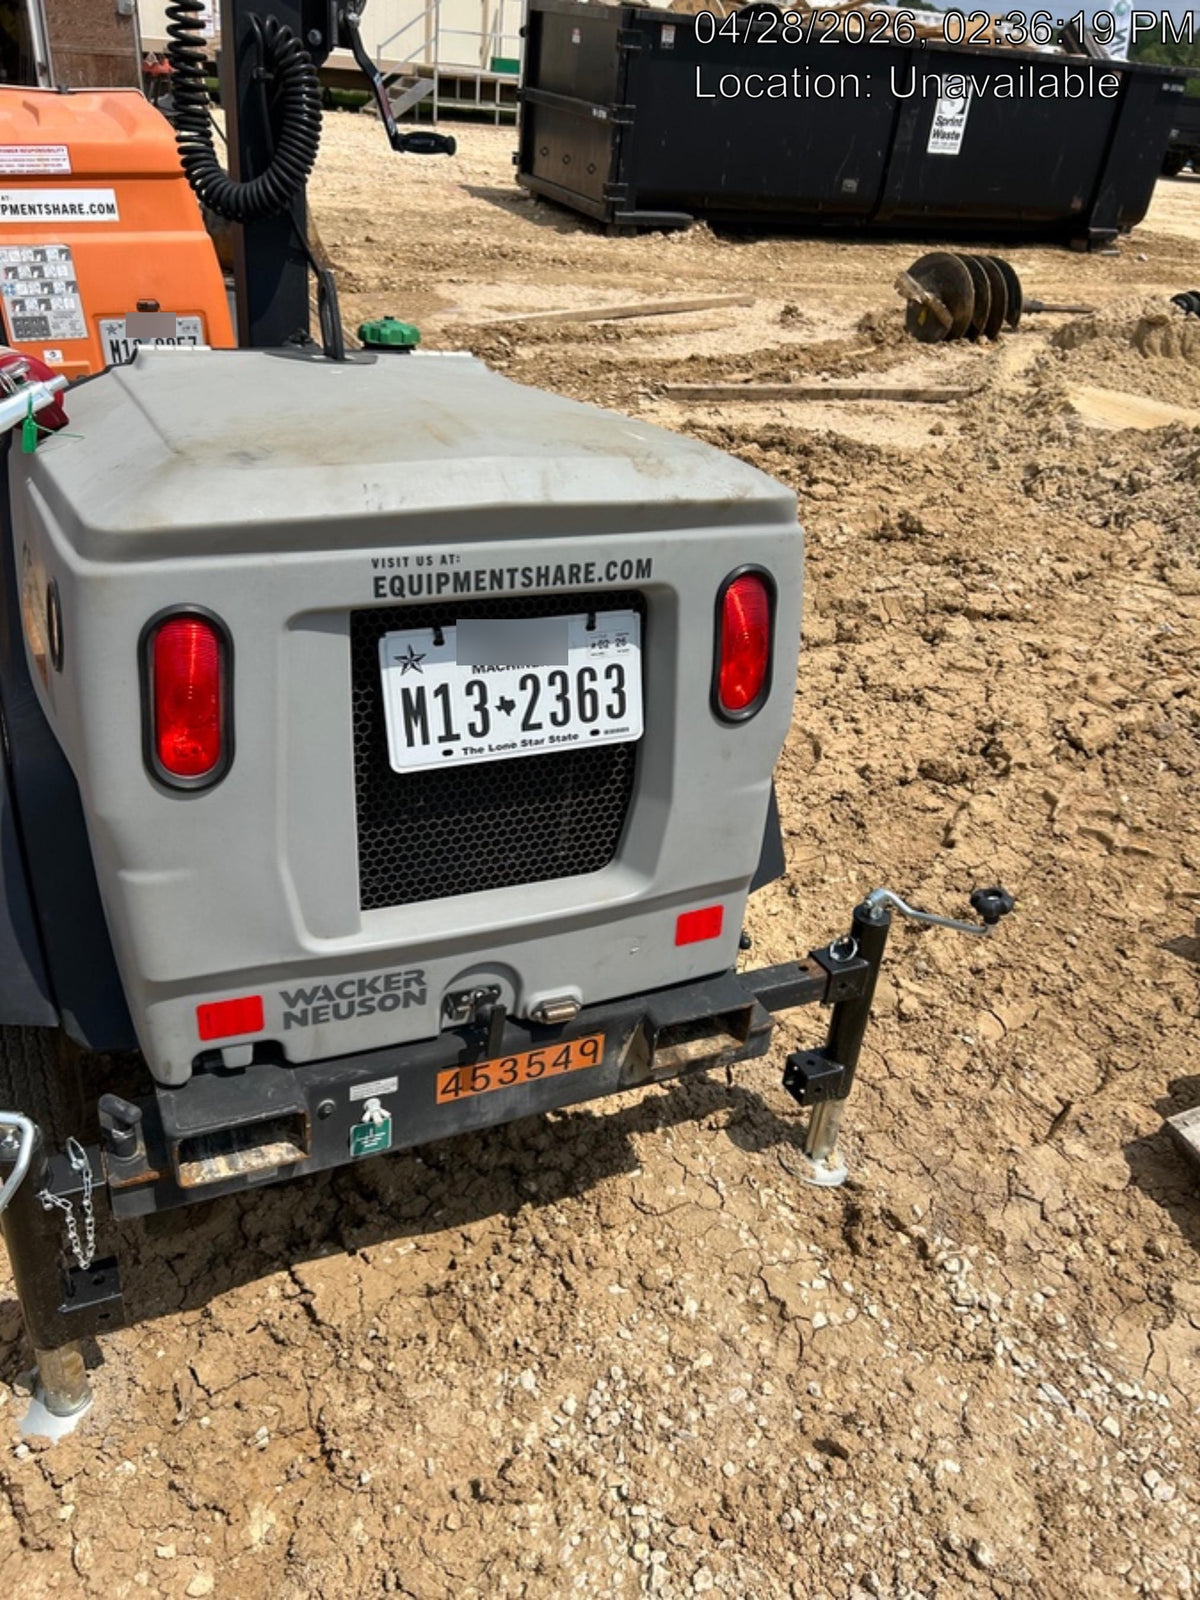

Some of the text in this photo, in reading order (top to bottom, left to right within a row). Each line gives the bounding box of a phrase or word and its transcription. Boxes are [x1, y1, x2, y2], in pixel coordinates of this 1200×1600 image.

[932, 128, 960, 140] Waste
[935, 115, 964, 127] Sprint
[371, 554, 461, 569] VISIT US AT:
[373, 558, 652, 598] EQUIPMENTSHARE.COM
[401, 663, 627, 748] M13 2363
[462, 731, 580, 756] The Lone Star State
[278, 968, 427, 1009] WACKER
[283, 988, 427, 1030] NEUSON
[439, 1038, 600, 1098] 453549
